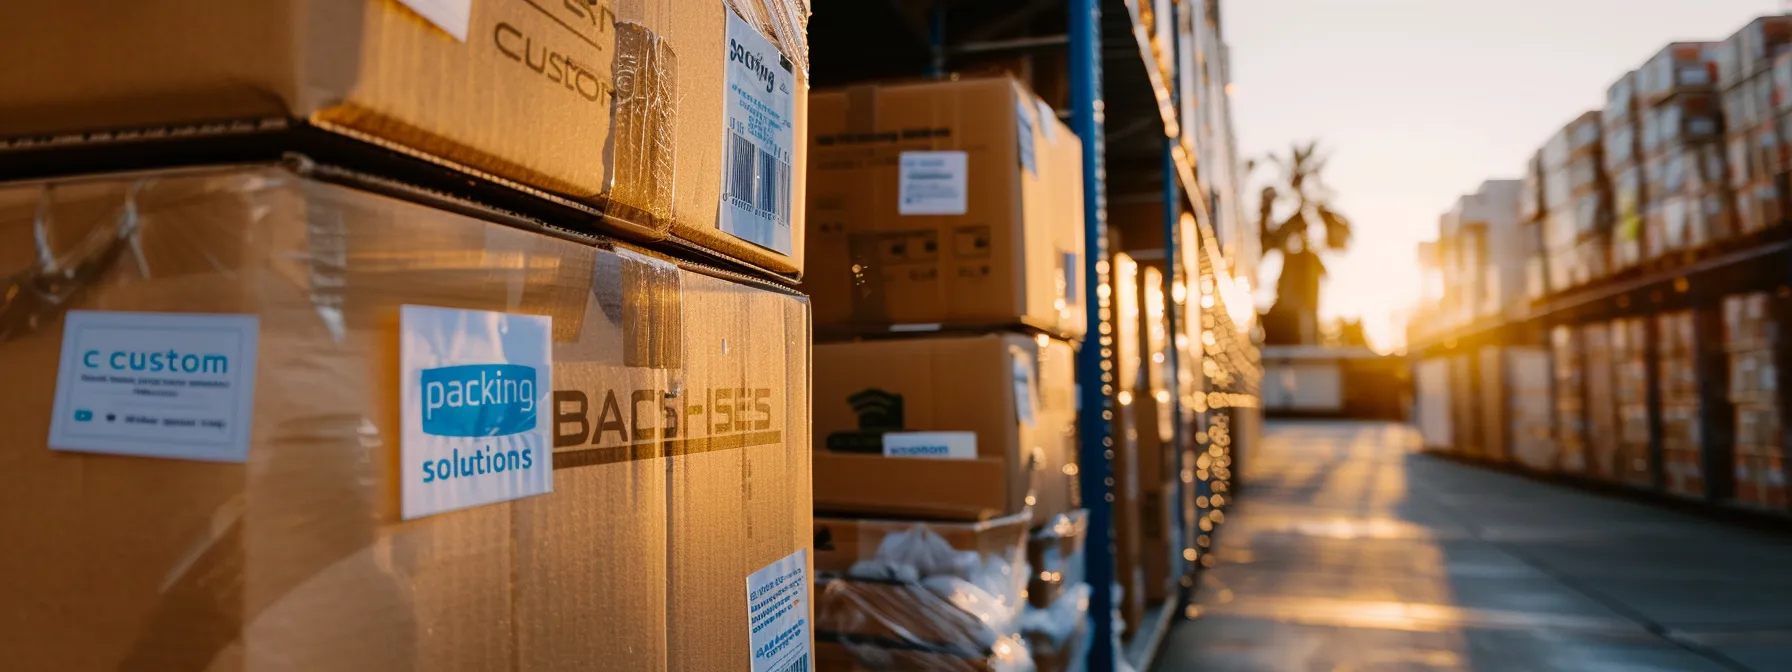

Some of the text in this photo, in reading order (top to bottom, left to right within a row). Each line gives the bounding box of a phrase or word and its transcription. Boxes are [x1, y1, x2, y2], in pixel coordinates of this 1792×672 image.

[83, 349, 229, 374] c custom
[426, 370, 534, 421] packing
[423, 446, 533, 484] solutions
